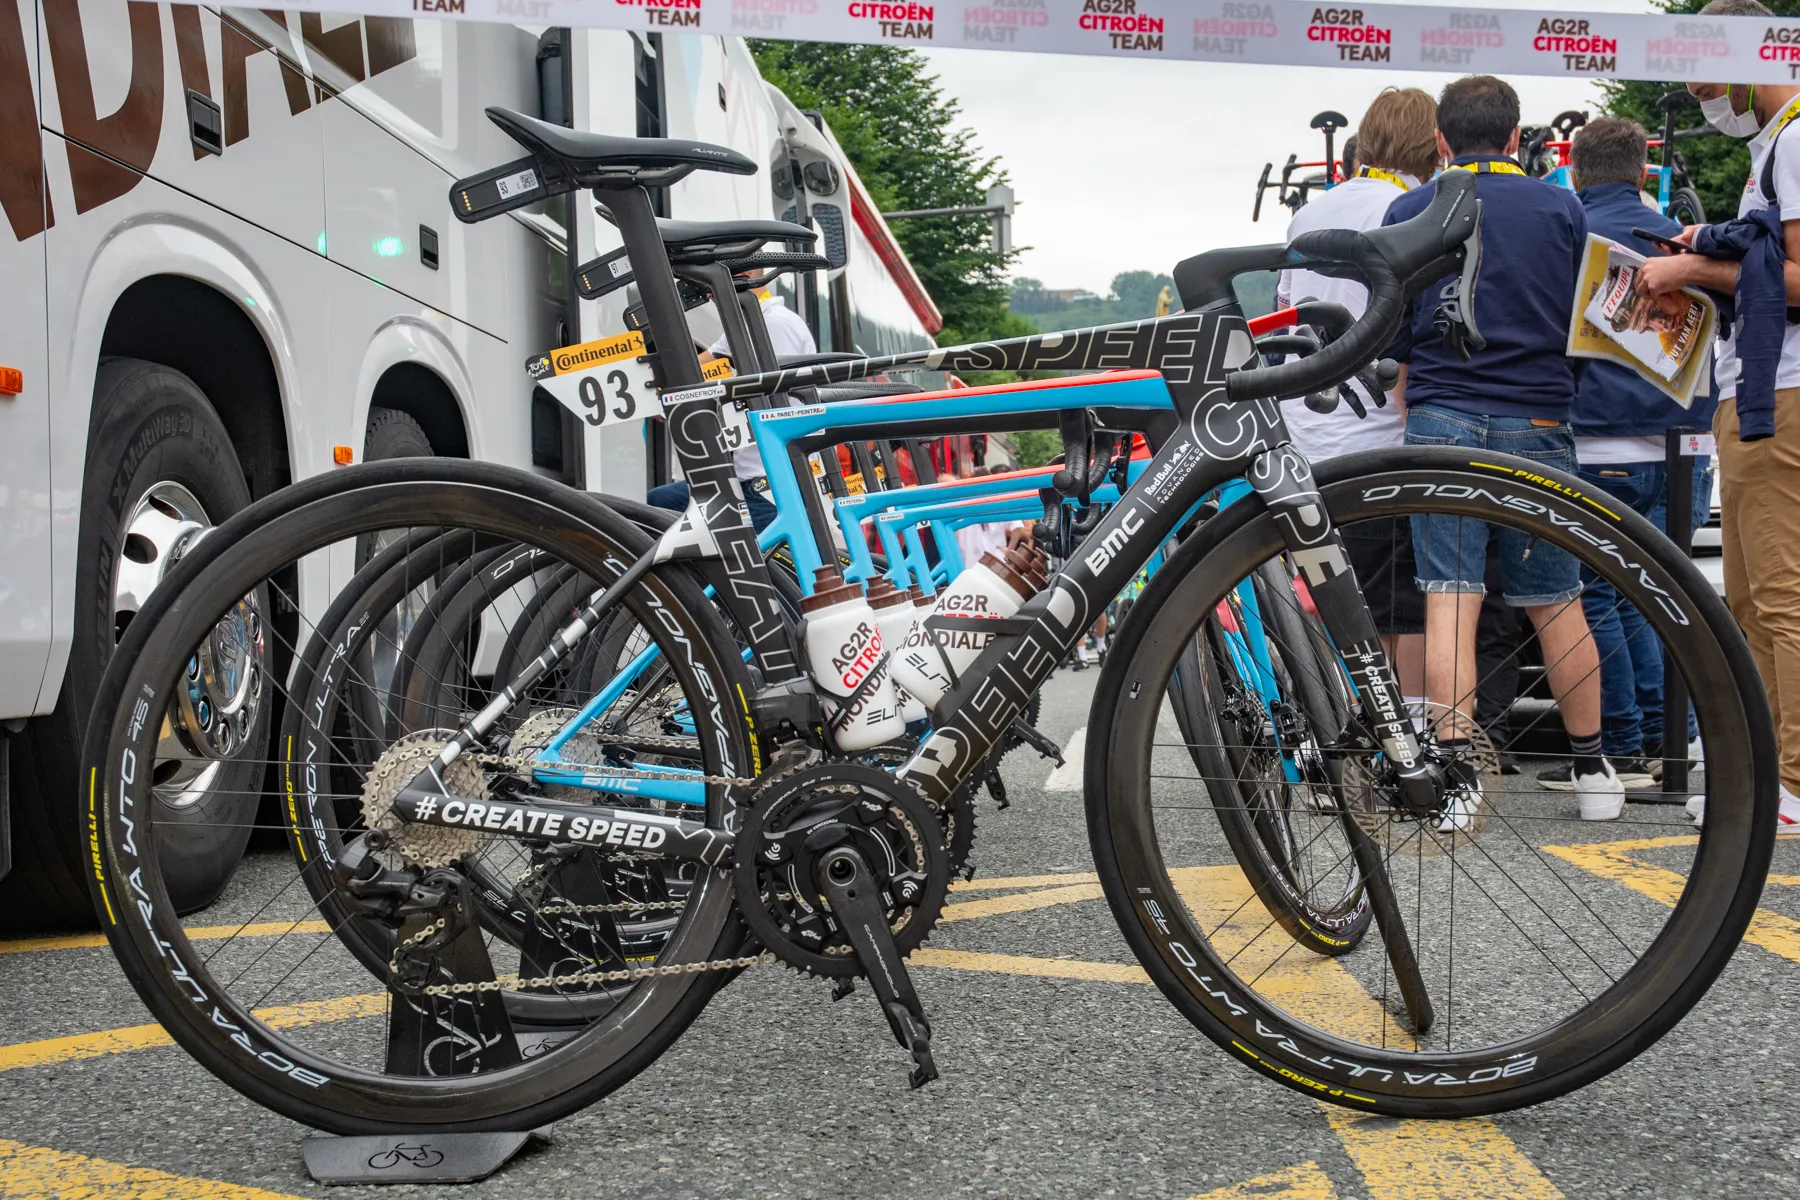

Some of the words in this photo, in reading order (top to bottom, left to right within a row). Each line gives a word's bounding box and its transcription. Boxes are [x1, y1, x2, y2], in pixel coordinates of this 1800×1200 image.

[411, 0, 465, 13] TEAM
[645, 8, 701, 28] TEAM
[848, 3, 934, 21] CITROËN
[1082, 0, 1137, 15] AG2R
[1310, 8, 1365, 26] AG2R
[878, 20, 934, 39] TEAM
[1078, 14, 1164, 34] CITROËN
[1307, 25, 1392, 44] CITROËN
[1537, 17, 1590, 36] AG2R
[1762, 27, 1800, 44] AG2
[1109, 32, 1164, 52] TEAM
[1337, 43, 1391, 63] TEAM
[1532, 35, 1617, 55] CITROËN
[1758, 45, 1800, 62] CITR
[1562, 53, 1617, 73] TEAM
[556, 338, 633, 371] Continental
[578, 370, 637, 427] 93
[674, 388, 717, 402] COSNEFROY
[1160, 451, 1205, 505] TECHNOLOGIES
[1513, 469, 1582, 499] PIRELLI
[1084, 508, 1145, 578] BMC
[1362, 483, 1690, 627] CAMPAGNOLO
[934, 594, 989, 613] AG2R
[832, 621, 873, 675] AG2R
[311, 625, 361, 730] ULTRA
[838, 663, 889, 732] MONDIA
[1365, 665, 1398, 721] CREATE
[1387, 722, 1417, 769] SPEED
[581, 772, 642, 793] BMC
[119, 747, 139, 857] WTO
[414, 795, 437, 822] #
[440, 799, 565, 838] CREATE
[567, 816, 667, 850] SPEED
[88, 813, 103, 881] PIRELLI
[128, 868, 208, 1003] ULTRA
[1169, 941, 1249, 1017] WTO
[211, 1005, 331, 1089] BORA
[1254, 1017, 1396, 1084] ULTRA
[1278, 1068, 1329, 1093] ZERO
[1403, 1054, 1538, 1087] BORA
